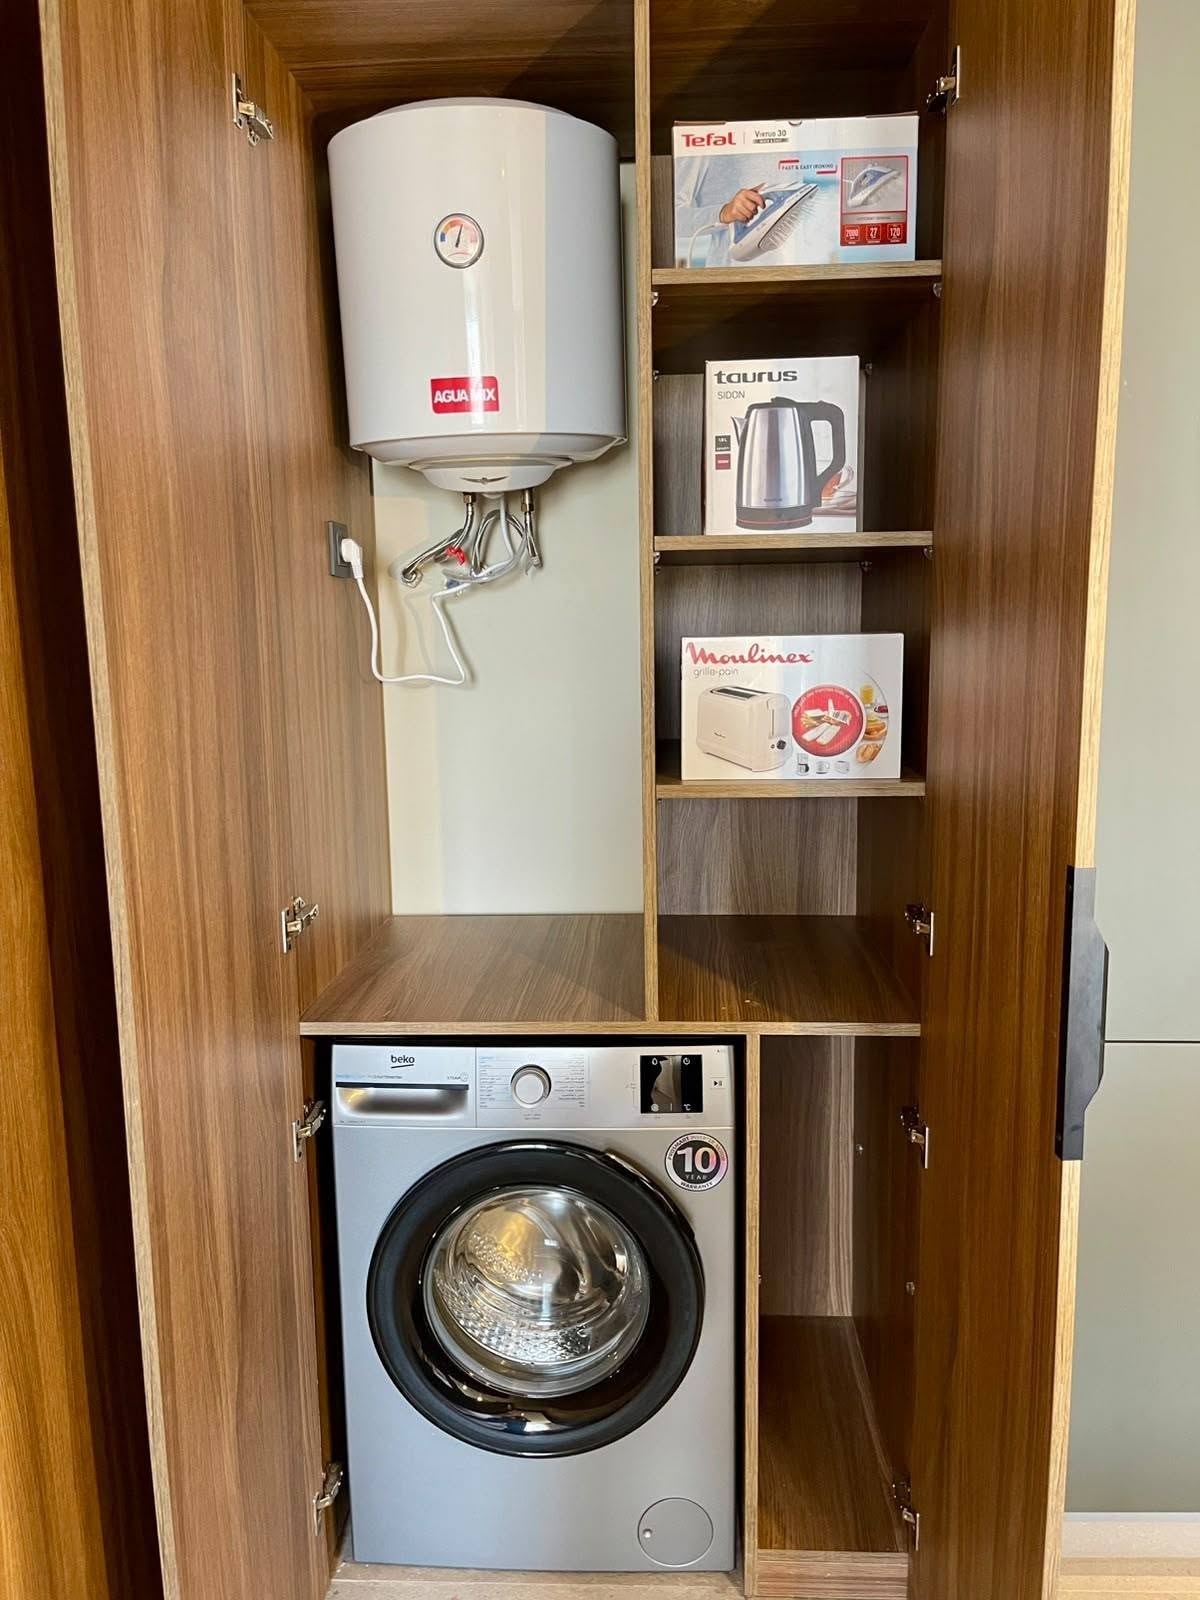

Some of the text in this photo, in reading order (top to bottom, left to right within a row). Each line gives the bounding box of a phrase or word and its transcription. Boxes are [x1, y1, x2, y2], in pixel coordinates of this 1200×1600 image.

[777, 129, 787, 137] 30
[681, 132, 736, 147] Tefal
[869, 227, 878, 237] 27
[890, 227, 901, 237] 120
[714, 370, 798, 384] taurus
[434, 389, 469, 403] AGUA
[717, 390, 745, 400] SIDON
[686, 642, 812, 665] Moulinex
[693, 666, 739, 678] grille-pain
[391, 1055, 415, 1064] beko
[677, 1147, 717, 1173] 10
[680, 1181, 713, 1189] WARRANTY
